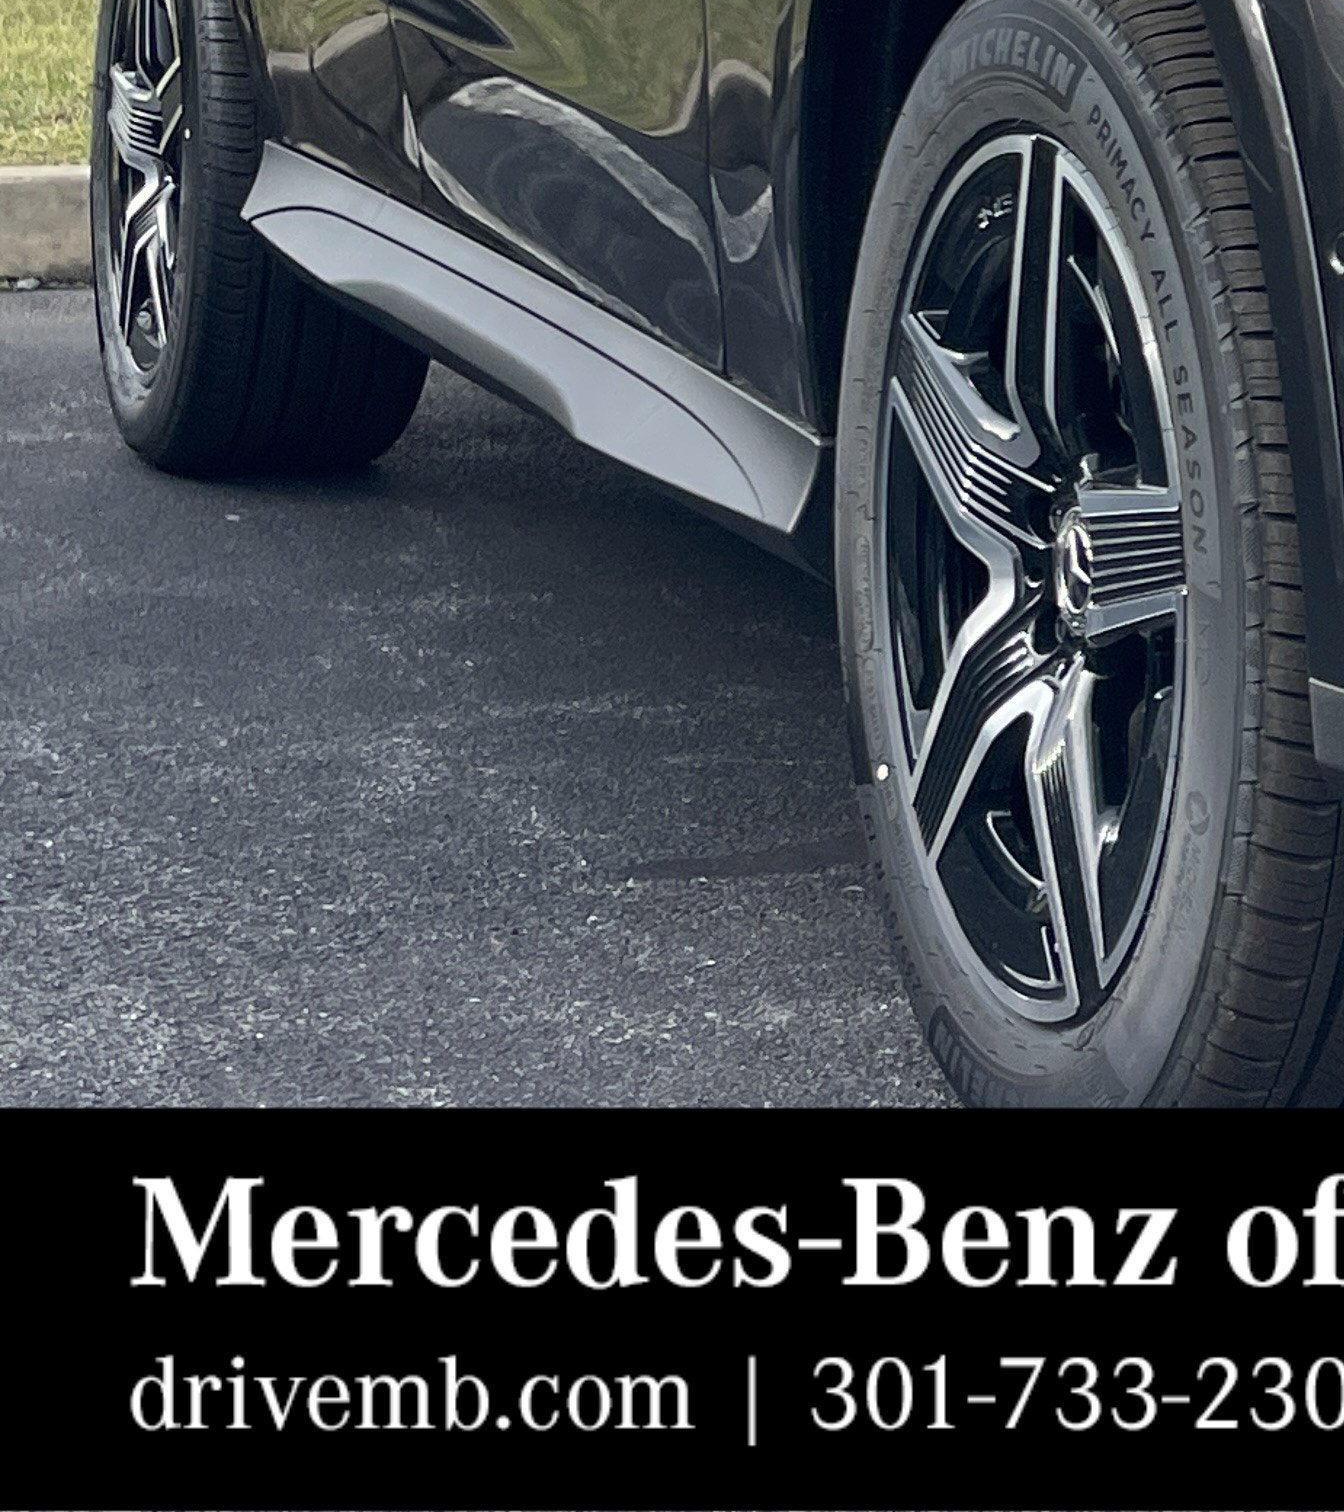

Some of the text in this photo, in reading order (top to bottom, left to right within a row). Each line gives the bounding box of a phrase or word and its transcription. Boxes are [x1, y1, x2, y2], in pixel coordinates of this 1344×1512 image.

[947, 27, 1078, 98] MICHELIN
[1087, 104, 1207, 556] PRIMACY ALL SEASON
